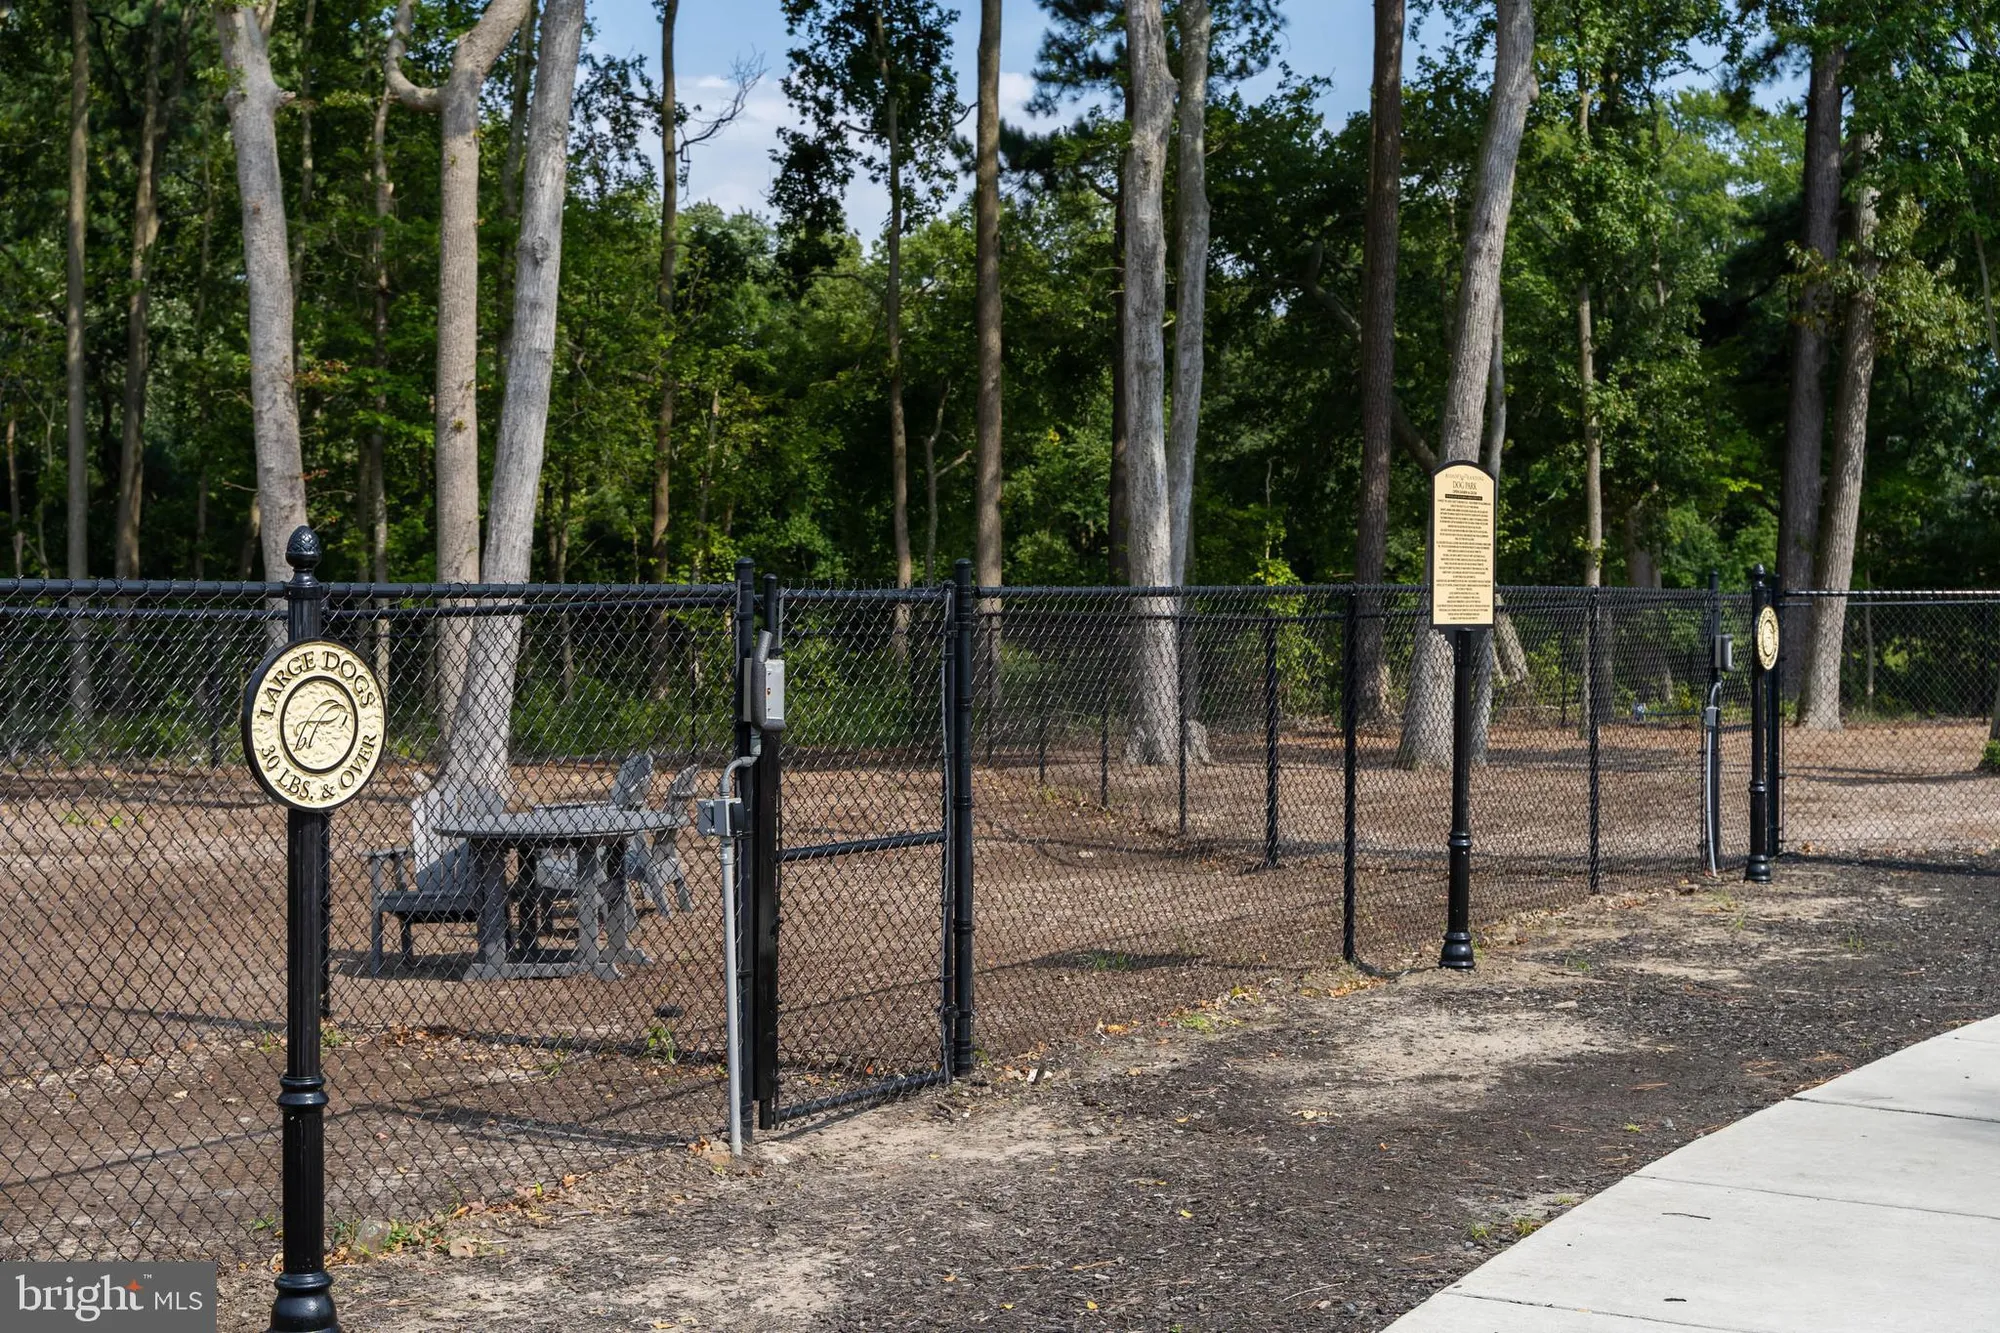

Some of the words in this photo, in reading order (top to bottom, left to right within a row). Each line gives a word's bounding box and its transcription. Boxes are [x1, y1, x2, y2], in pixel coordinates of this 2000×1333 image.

[1452, 480, 1464, 489] DOG
[1465, 481, 1477, 490] PARK
[257, 650, 317, 720] LARGE
[321, 650, 376, 709] DOGS
[260, 744, 281, 772] 30
[276, 767, 313, 800] LBS.
[320, 782, 337, 800] &
[339, 733, 378, 790] OVER
